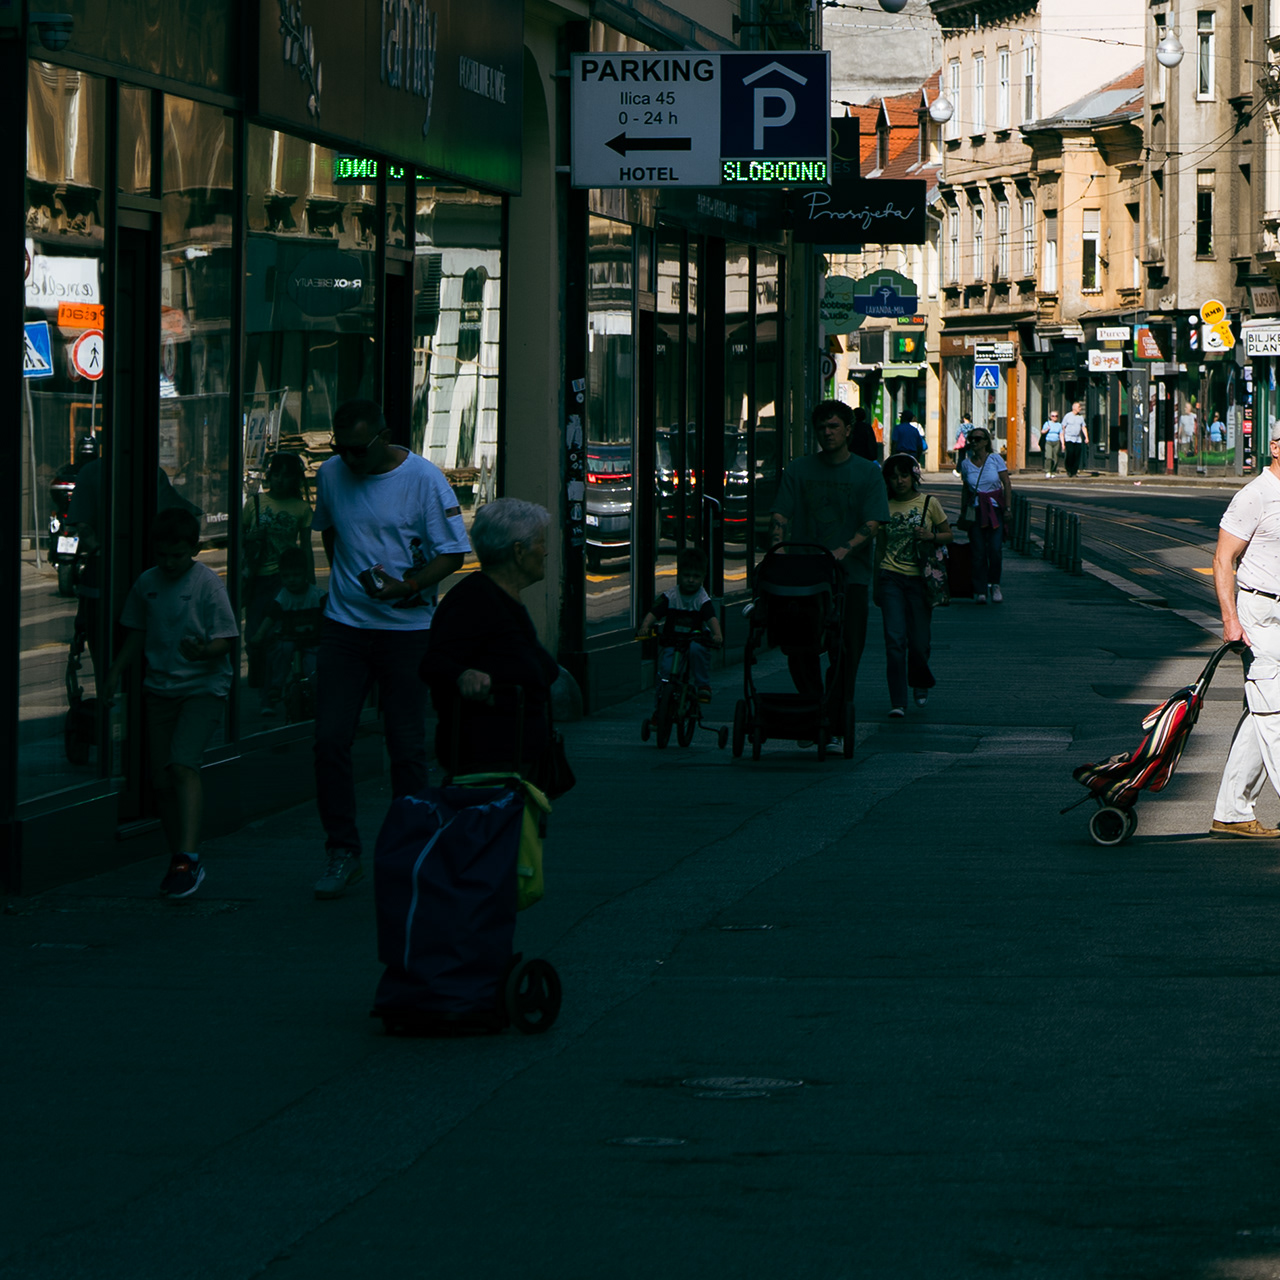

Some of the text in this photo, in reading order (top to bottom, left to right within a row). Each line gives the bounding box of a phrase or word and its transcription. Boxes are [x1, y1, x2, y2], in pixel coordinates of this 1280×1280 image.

[581, 59, 714, 82] PARKING
[620, 91, 676, 106] Ilica 45
[618, 111, 627, 126] 0
[643, 111, 663, 125] 24
[669, 111, 678, 125] h
[753, 87, 796, 151] P
[619, 167, 679, 181] HOTEL
[723, 161, 827, 182] SLOBODNO
[1099, 330, 1127, 338] Purex
